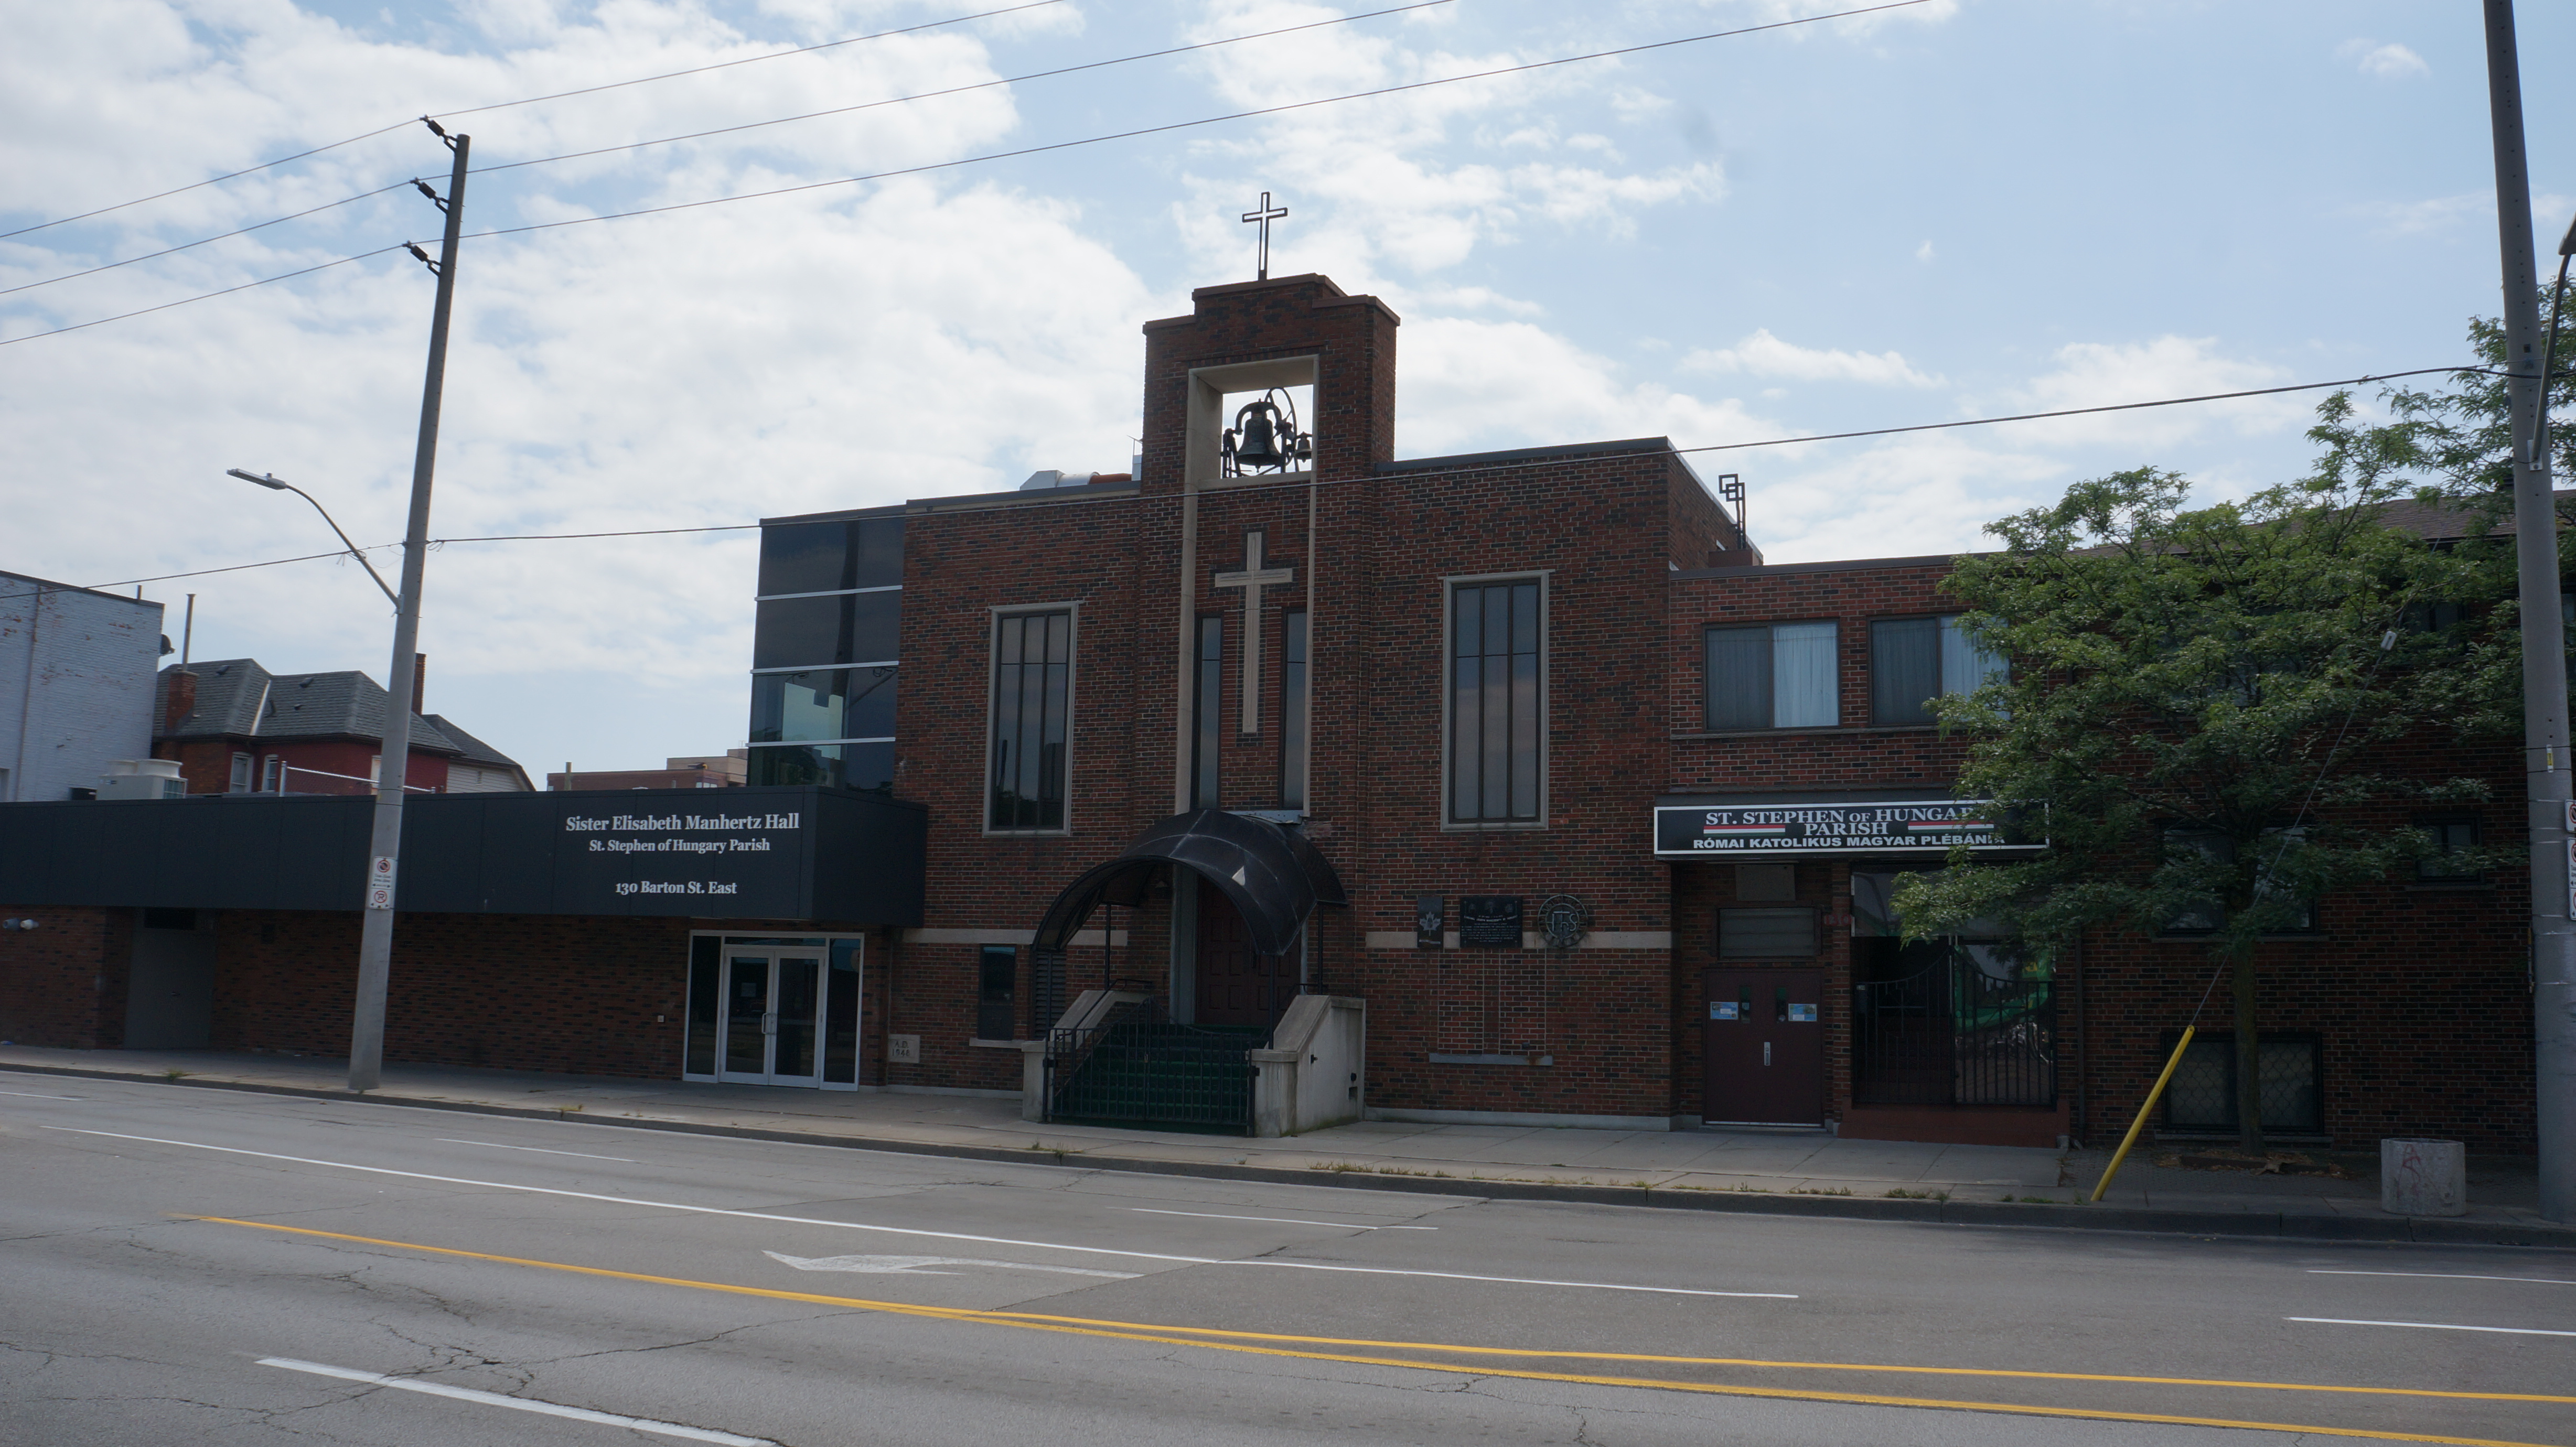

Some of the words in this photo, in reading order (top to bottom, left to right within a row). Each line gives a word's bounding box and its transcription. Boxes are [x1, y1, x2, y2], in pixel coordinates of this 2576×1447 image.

[566, 816, 609, 831] Sister
[612, 815, 682, 830] Elisabeth
[685, 814, 761, 829] Manhertz
[765, 813, 799, 828] Hall
[1706, 813, 1737, 825] ST.
[1743, 810, 1845, 824] STEPHEN
[1849, 813, 1870, 822] OF
[1875, 807, 1987, 822] HUNGA
[1804, 822, 1888, 835] PARISH
[589, 840, 605, 851] St.
[607, 839, 655, 854] Stephen
[658, 839, 672, 851] of
[673, 839, 727, 854] Hungary
[729, 838, 770, 851] Parish
[1694, 838, 1744, 848] RÓMAI
[1750, 837, 1842, 848] KATOLIKUS
[1847, 836, 1916, 846] MAGYAR
[616, 883, 638, 895] 130
[640, 881, 684, 893] Barton
[688, 881, 704, 893] St.
[708, 882, 737, 893] East
